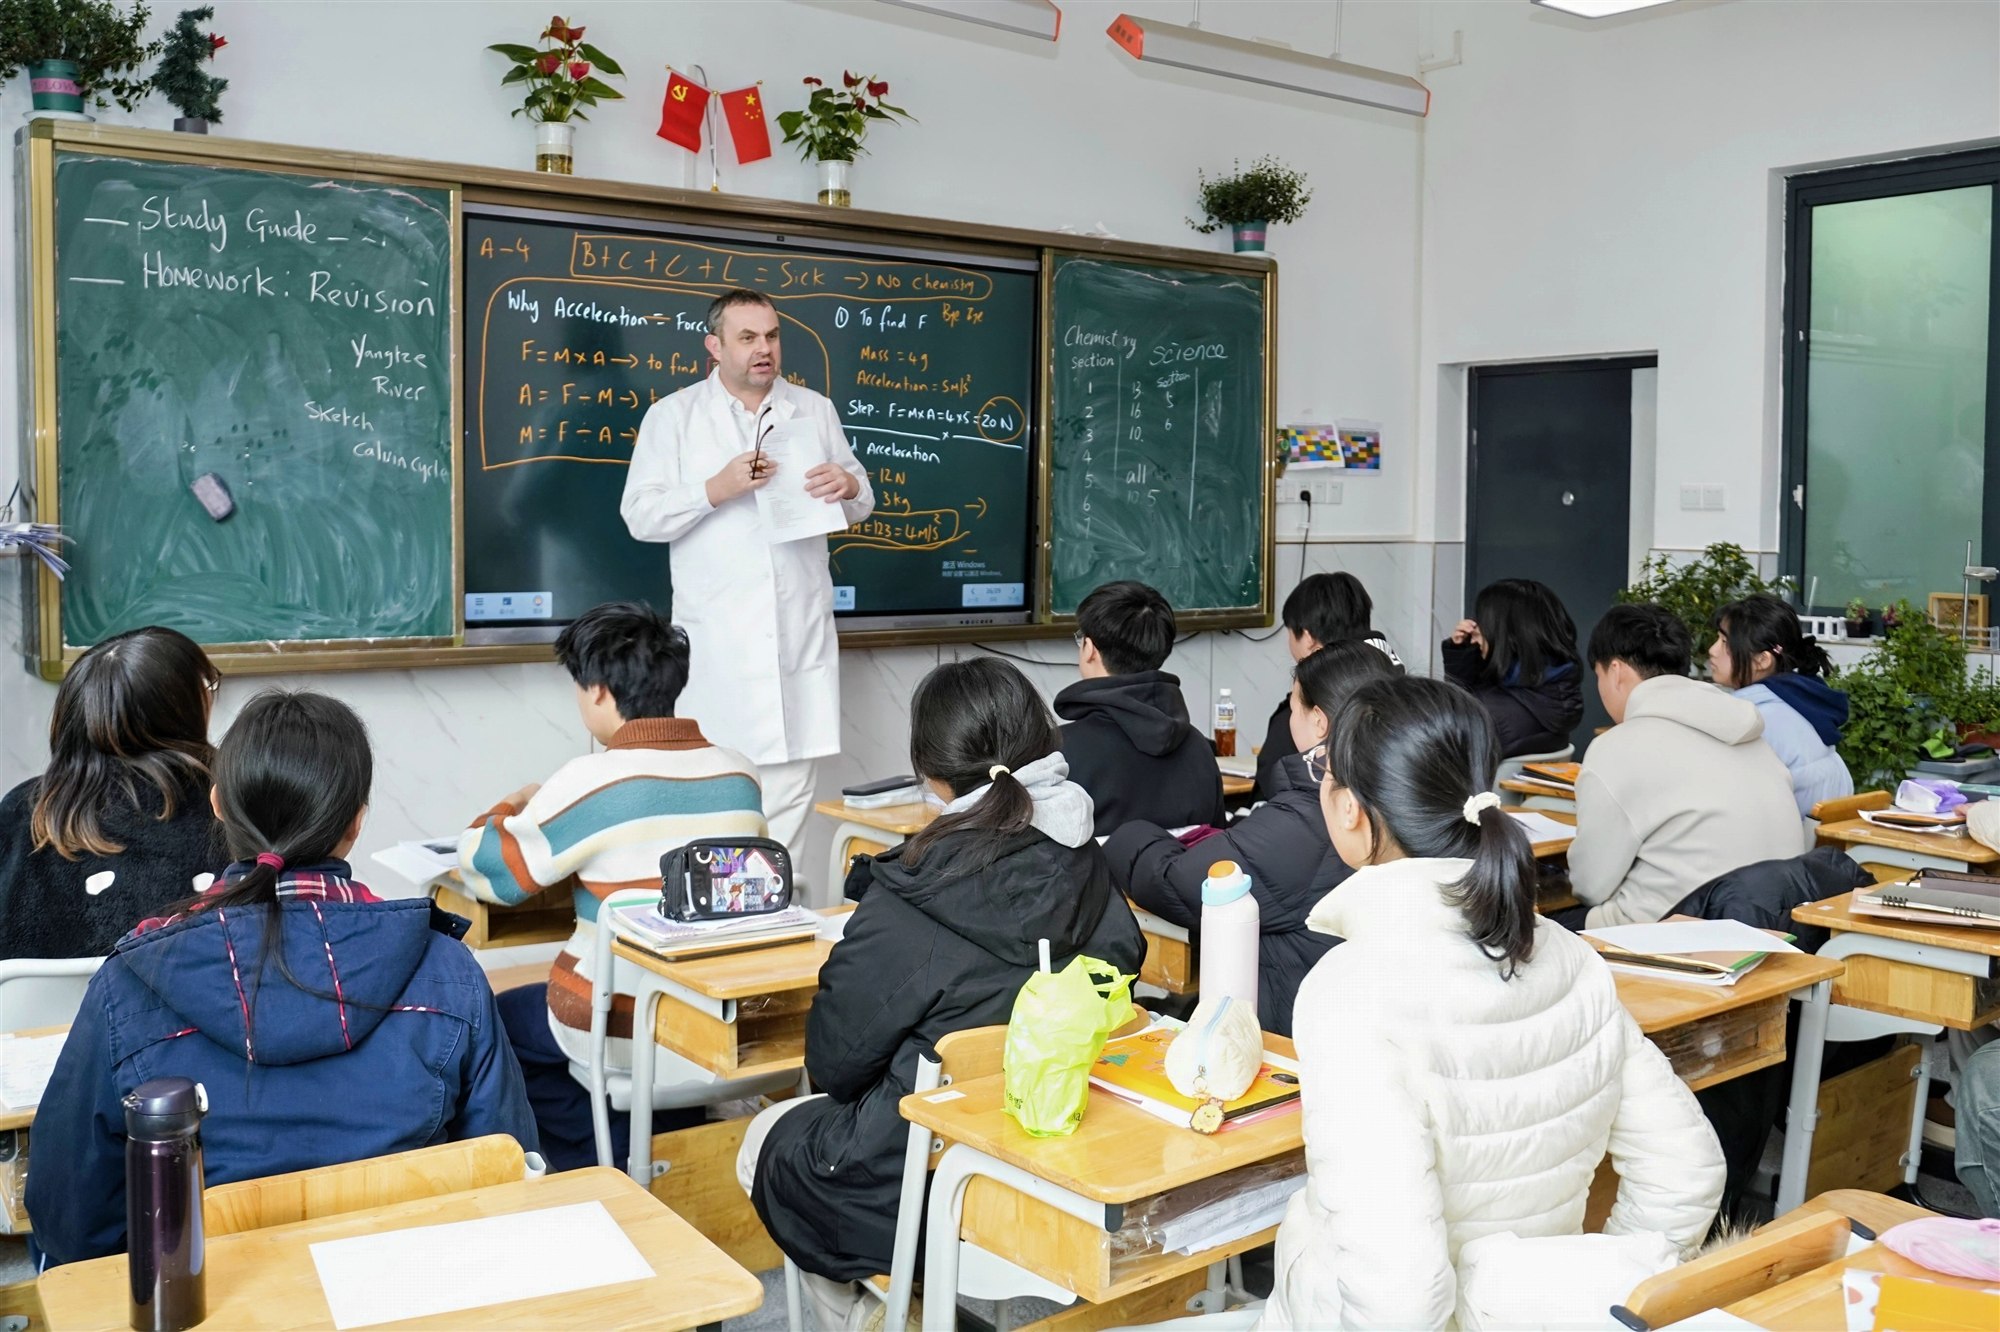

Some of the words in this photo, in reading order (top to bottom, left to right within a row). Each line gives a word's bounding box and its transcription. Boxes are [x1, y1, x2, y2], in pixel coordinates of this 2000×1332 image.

[142, 196, 227, 253] Study
[246, 208, 317, 244] Guide
[780, 261, 825, 288] Sick
[309, 271, 435, 317] Revision
[507, 289, 539, 324] Why
[554, 297, 648, 328] Acceleration
[860, 307, 873, 327] To
[880, 305, 906, 332] find
[918, 314, 928, 329] F
[351, 334, 428, 369] Yangtze
[647, 353, 663, 370] to
[670, 352, 698, 376] find
[860, 345, 889, 362] Mass
[372, 375, 426, 401] River
[856, 369, 929, 392] Acceleration
[303, 401, 375, 431] Sketch
[1085, 406, 1094, 418] 2
[1130, 402, 1141, 419] 16
[1165, 418, 1172, 431] 6
[1085, 429, 1094, 442] 3
[866, 442, 941, 464] Acceleration
[1082, 450, 1092, 463] 4
[1085, 474, 1094, 488] 5
[1126, 463, 1146, 484] all
[1083, 494, 1091, 511] 6
